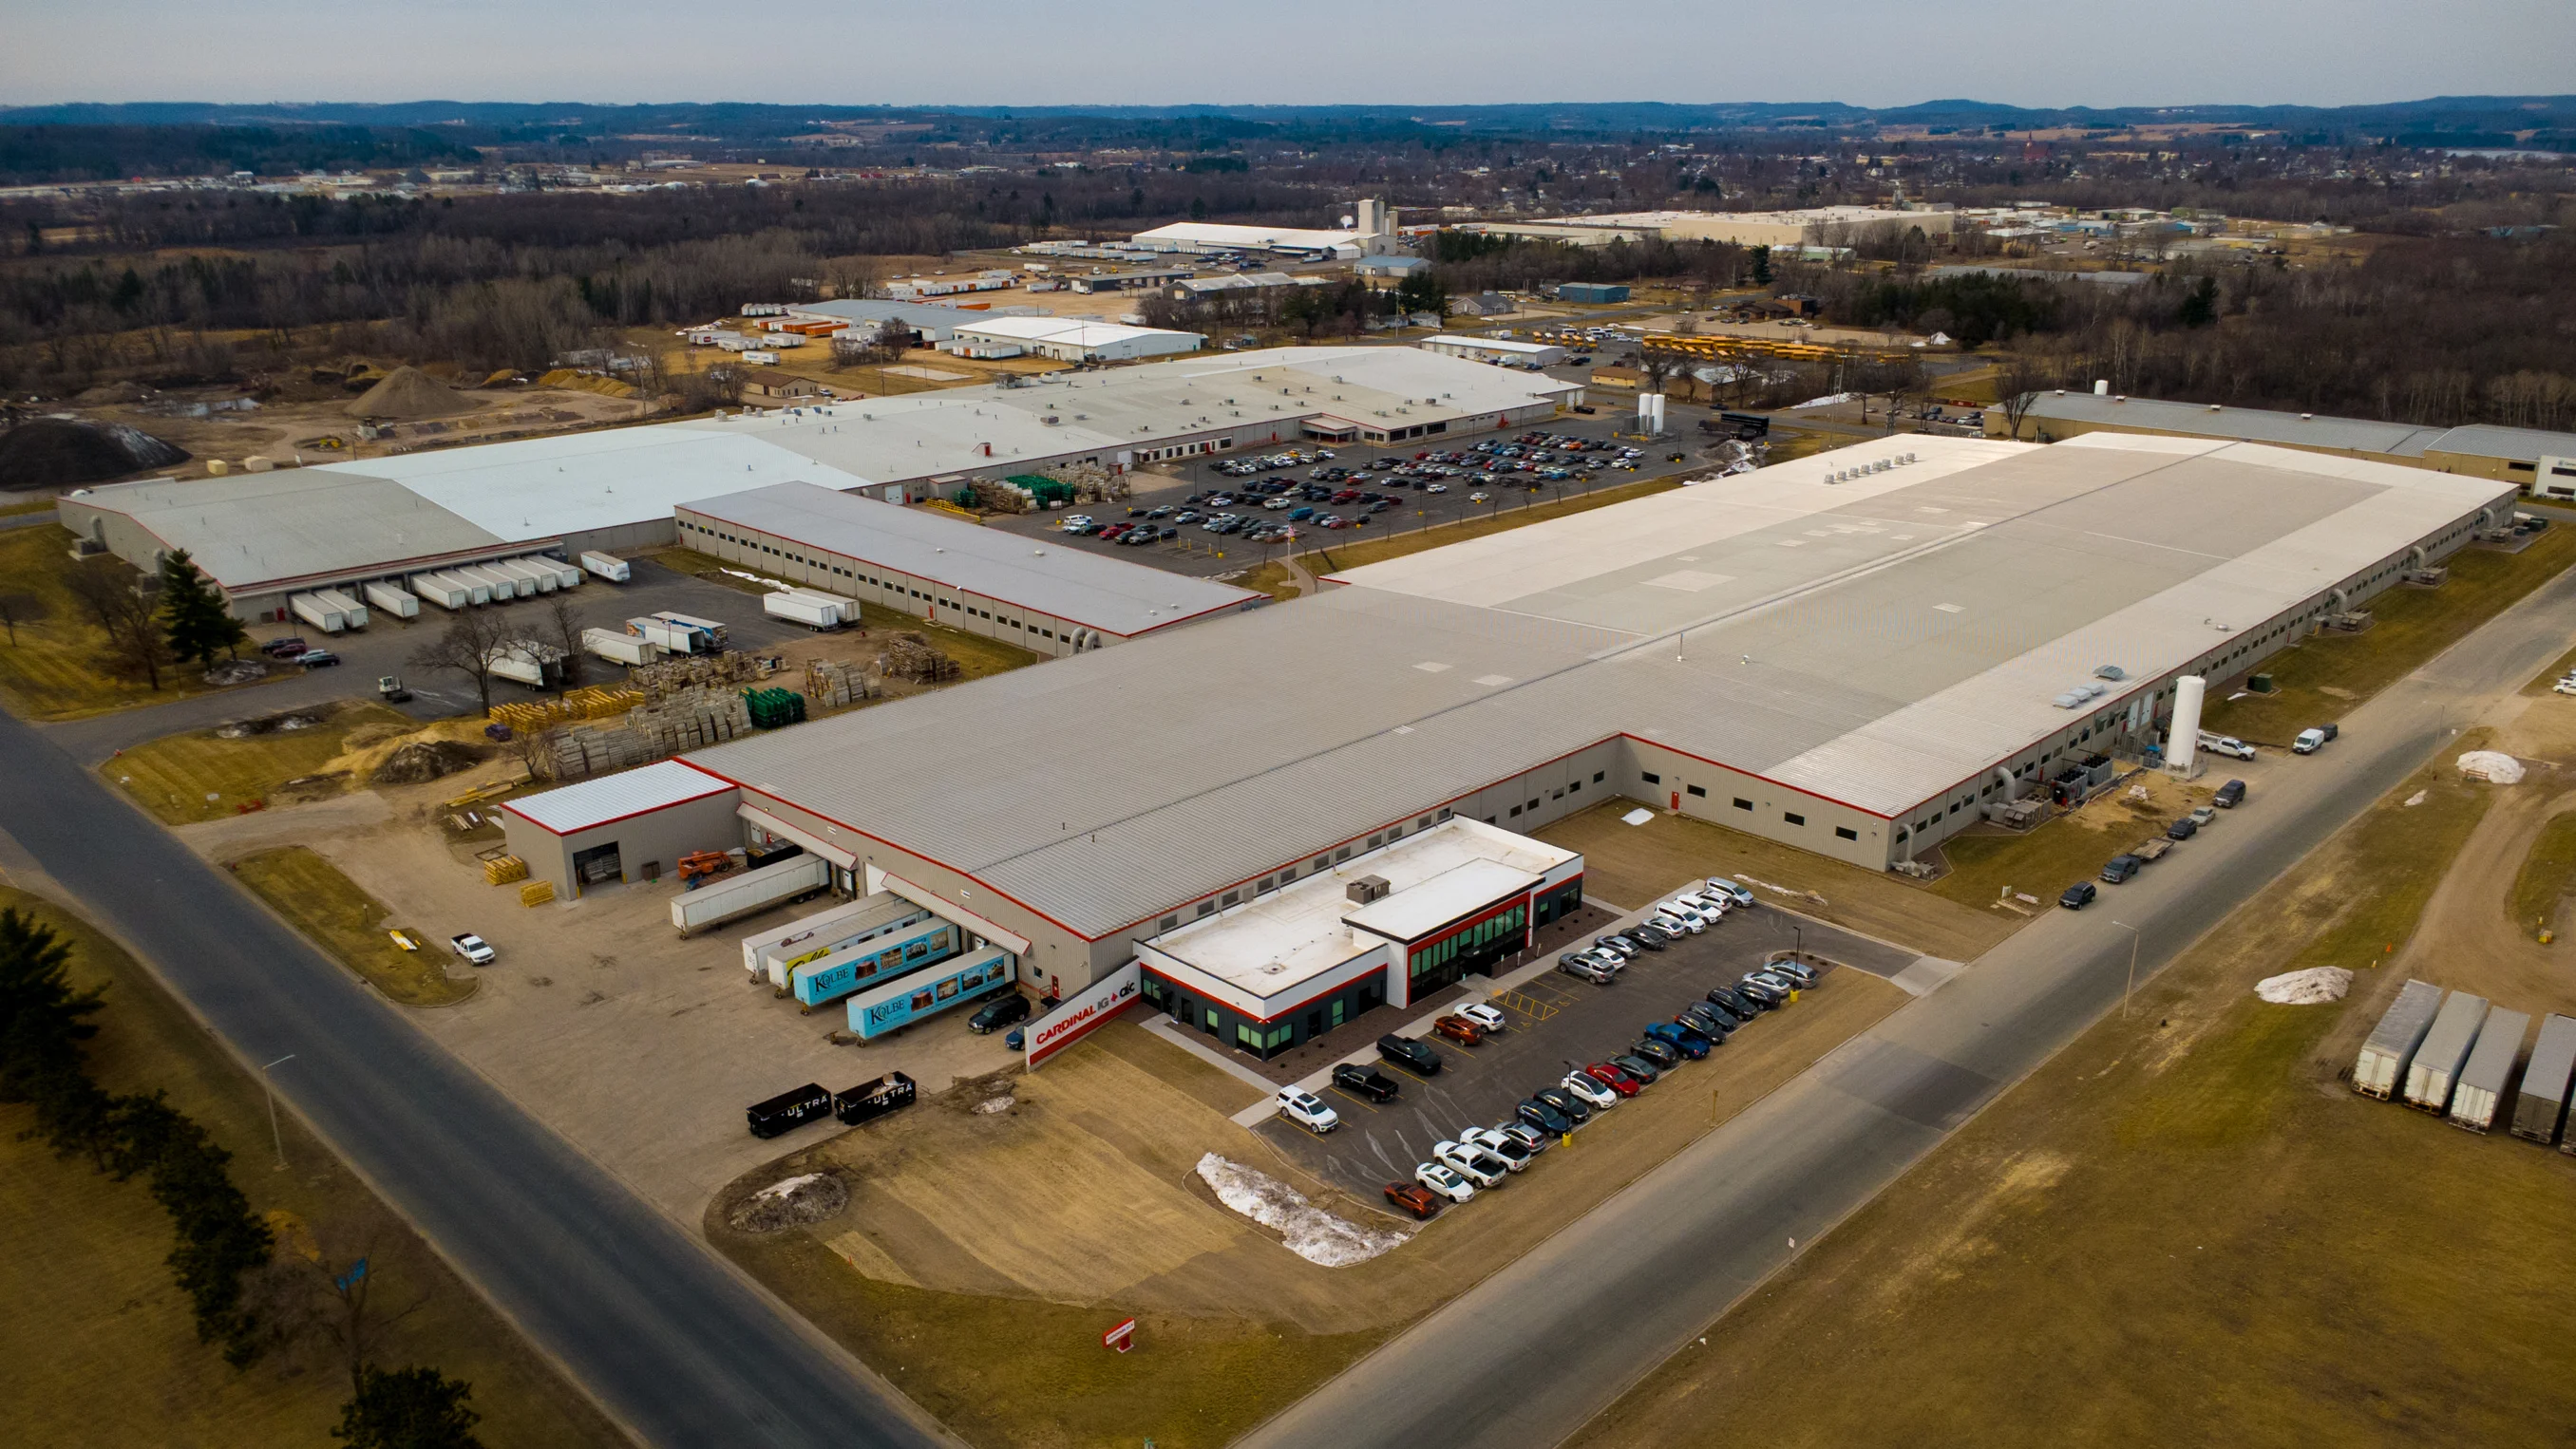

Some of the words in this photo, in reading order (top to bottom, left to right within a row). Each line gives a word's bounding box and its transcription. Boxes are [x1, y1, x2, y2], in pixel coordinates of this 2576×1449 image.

[814, 968, 850, 992] KOLBE
[870, 999, 904, 1026] KOLBE
[1036, 1006, 1096, 1044] CARDINAL
[1097, 997, 1109, 1010] IG
[873, 1083, 913, 1104] ULTRA
[786, 1095, 827, 1117] ULTRA
